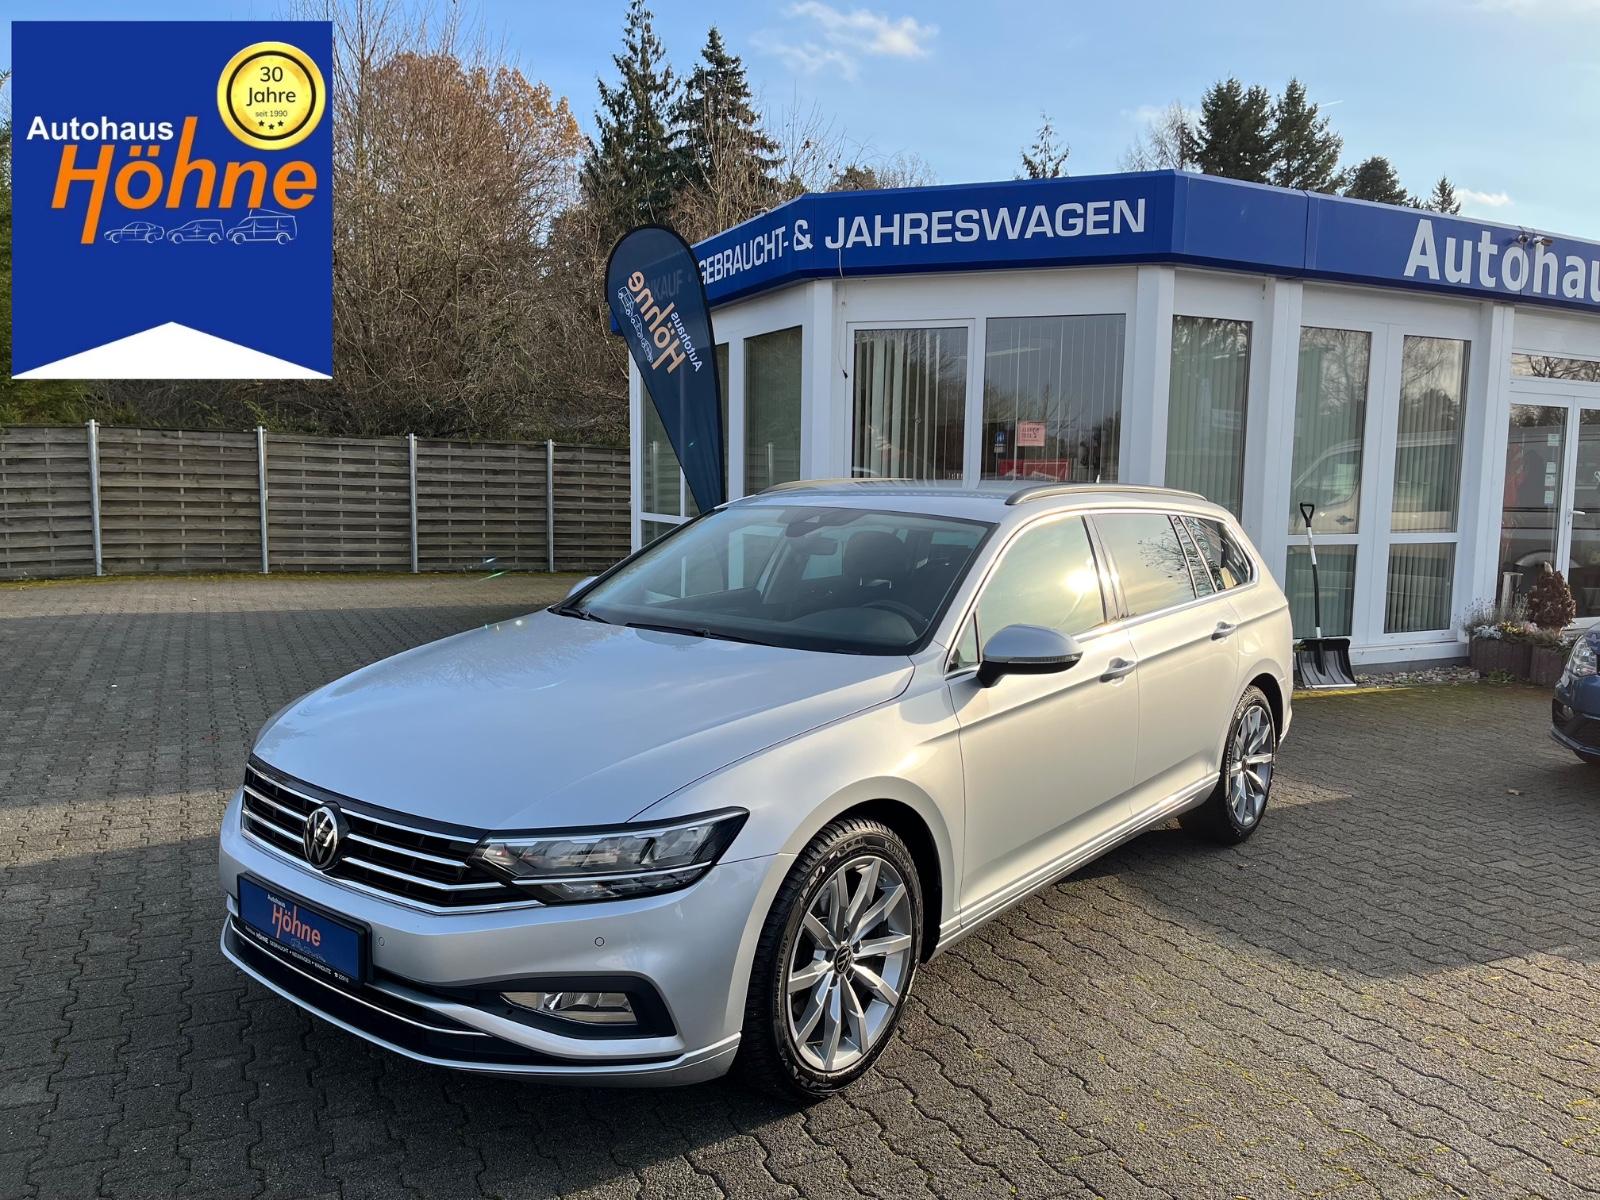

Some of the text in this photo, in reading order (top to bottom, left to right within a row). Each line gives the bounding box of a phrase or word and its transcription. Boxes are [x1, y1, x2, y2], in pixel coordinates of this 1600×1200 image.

[793, 219, 814, 251] &
[825, 198, 1146, 249] JAHRESWAGEN
[271, 903, 321, 947] Höhne
